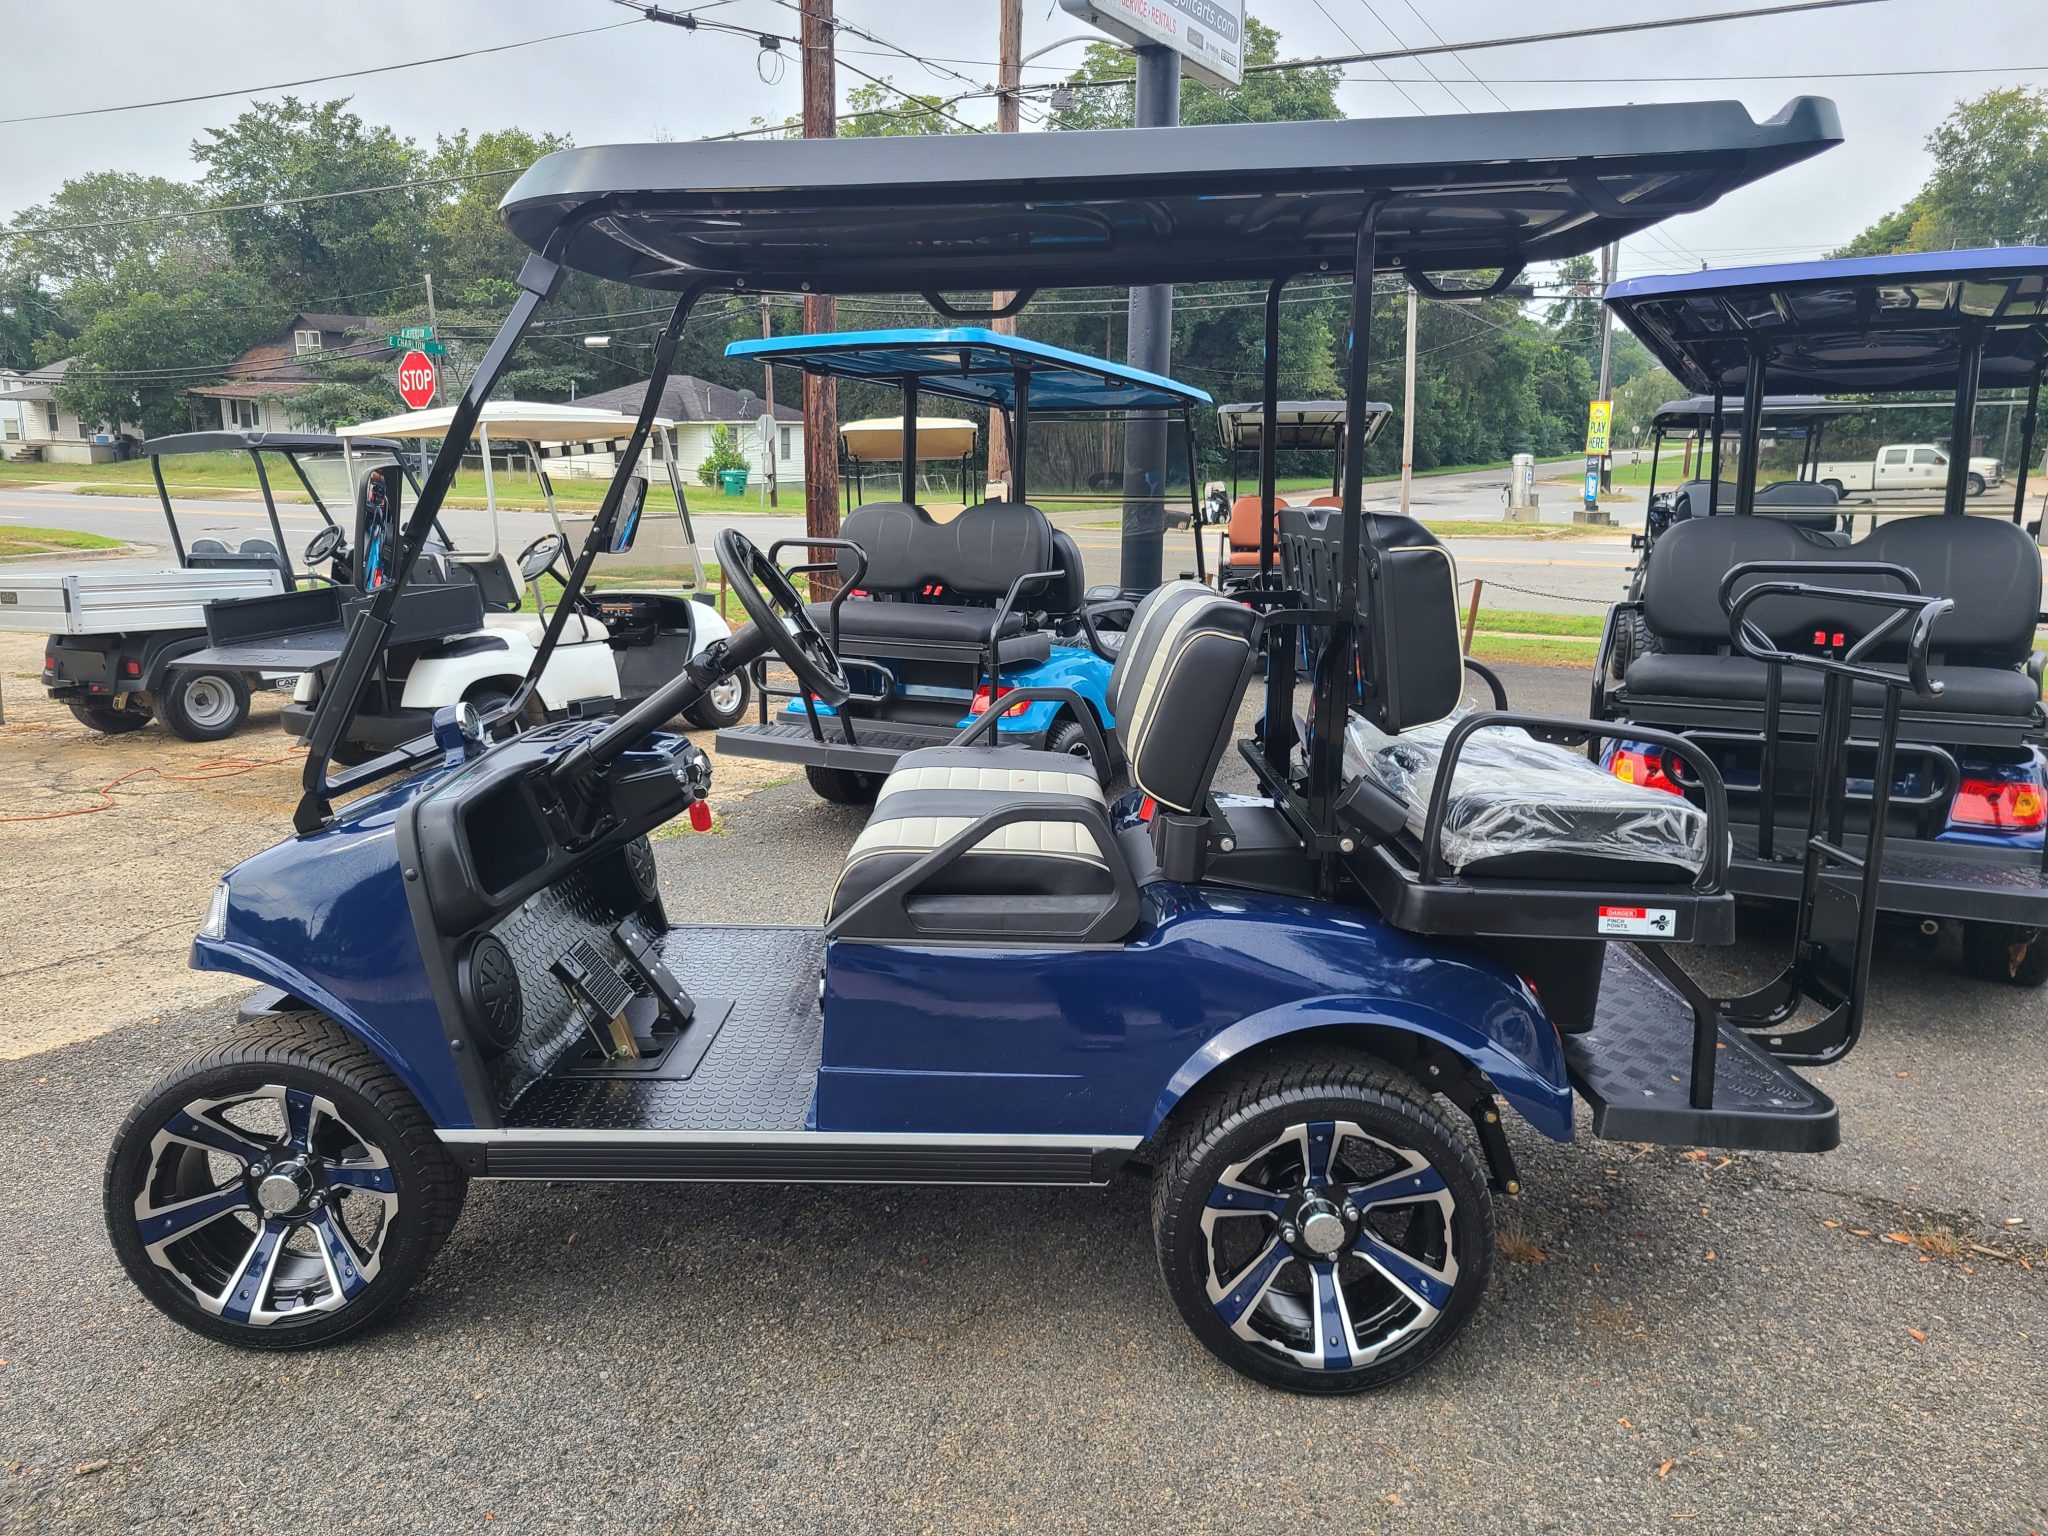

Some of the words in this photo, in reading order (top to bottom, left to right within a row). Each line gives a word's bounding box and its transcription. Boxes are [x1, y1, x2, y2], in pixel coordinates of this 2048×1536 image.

[1151, 6, 1177, 34] RENTALS
[389, 336, 395, 346] E
[397, 338, 426, 351] CHARLTON
[401, 369, 432, 391] STOP
[1590, 421, 1607, 434] PLAY
[1588, 436, 1606, 449] HERE
